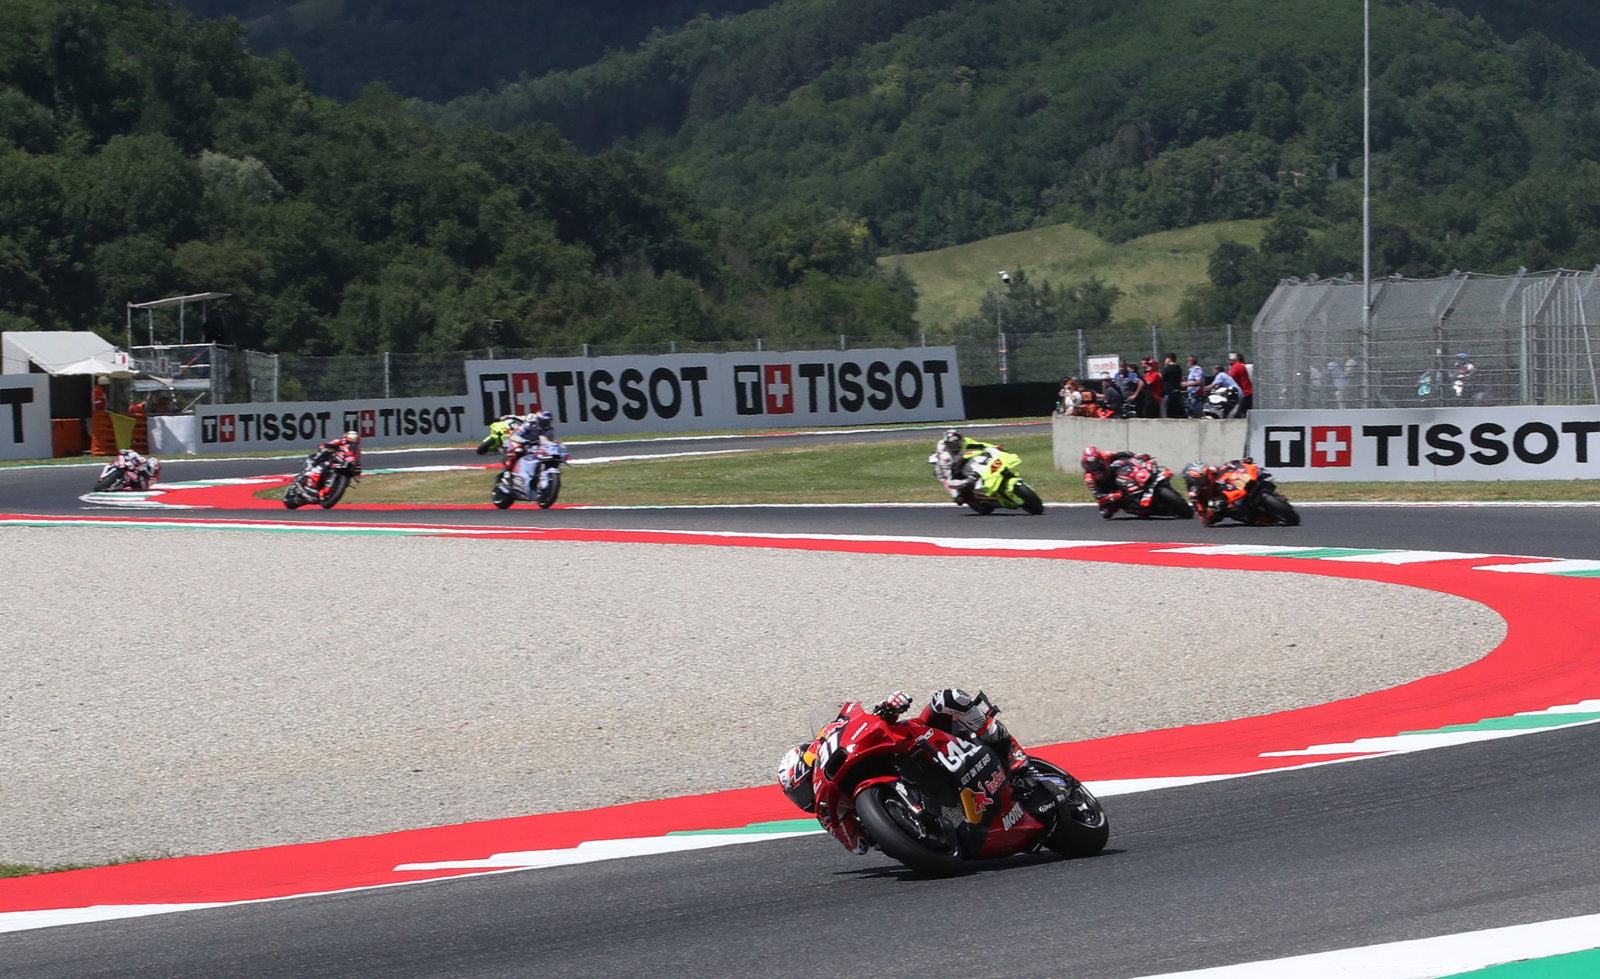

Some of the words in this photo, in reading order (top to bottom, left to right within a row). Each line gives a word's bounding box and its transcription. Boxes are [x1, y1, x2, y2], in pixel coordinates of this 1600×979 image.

[545, 366, 708, 423] TISSOT
[798, 359, 949, 413] TISSOT
[239, 412, 331, 442] TISSOT
[379, 406, 465, 437] TISSOT
[1362, 421, 1600, 466] TISSOT
[1001, 801, 1025, 832] MOTUL
